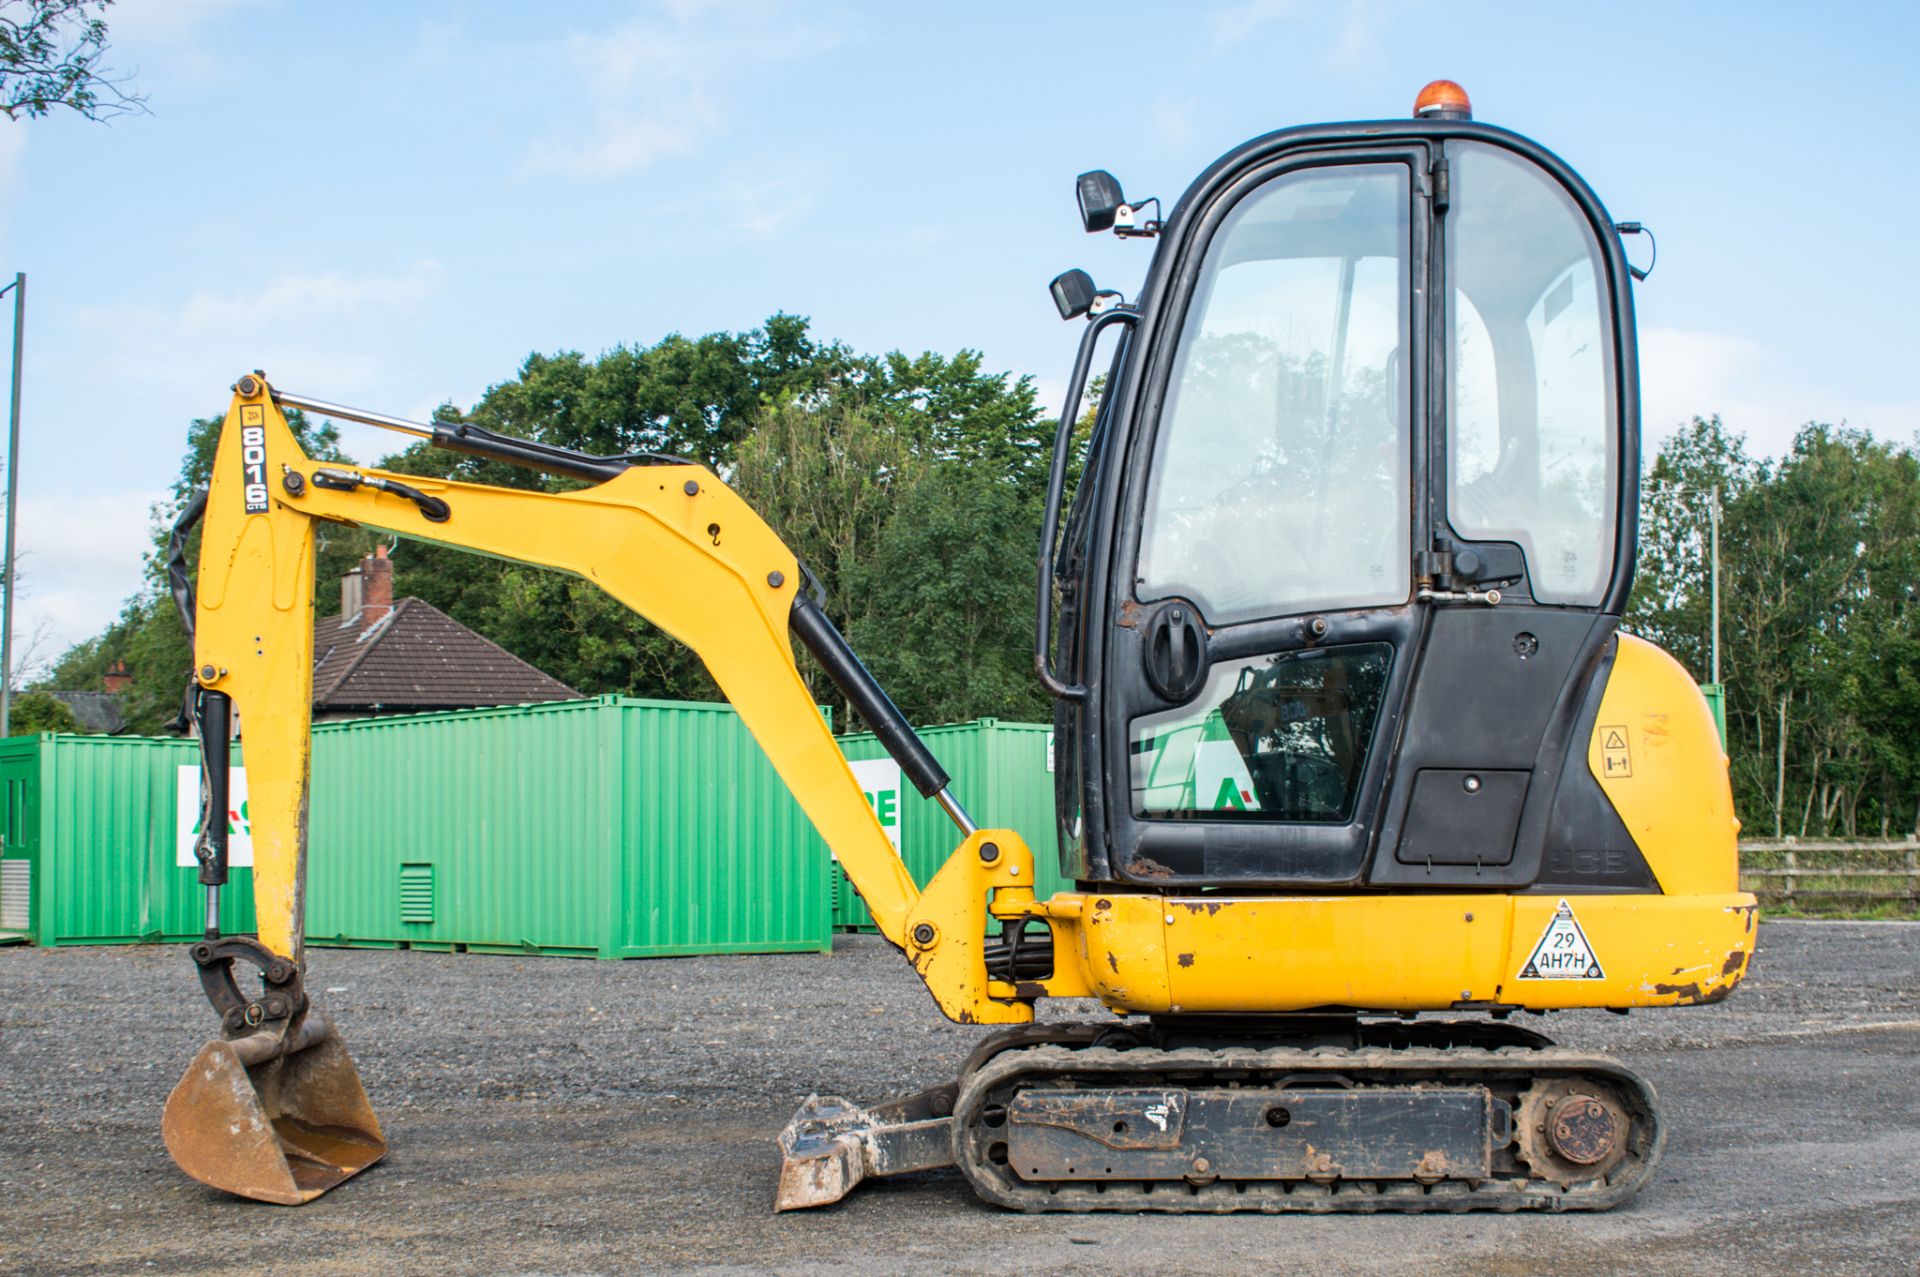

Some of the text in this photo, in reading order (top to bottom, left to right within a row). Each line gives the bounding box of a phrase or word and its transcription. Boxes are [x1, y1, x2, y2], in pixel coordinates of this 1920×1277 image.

[243, 427, 268, 503] 8016
[1551, 851, 1628, 873] JCB
[1554, 933, 1575, 948] 29
[1540, 953, 1585, 968] AH7H
